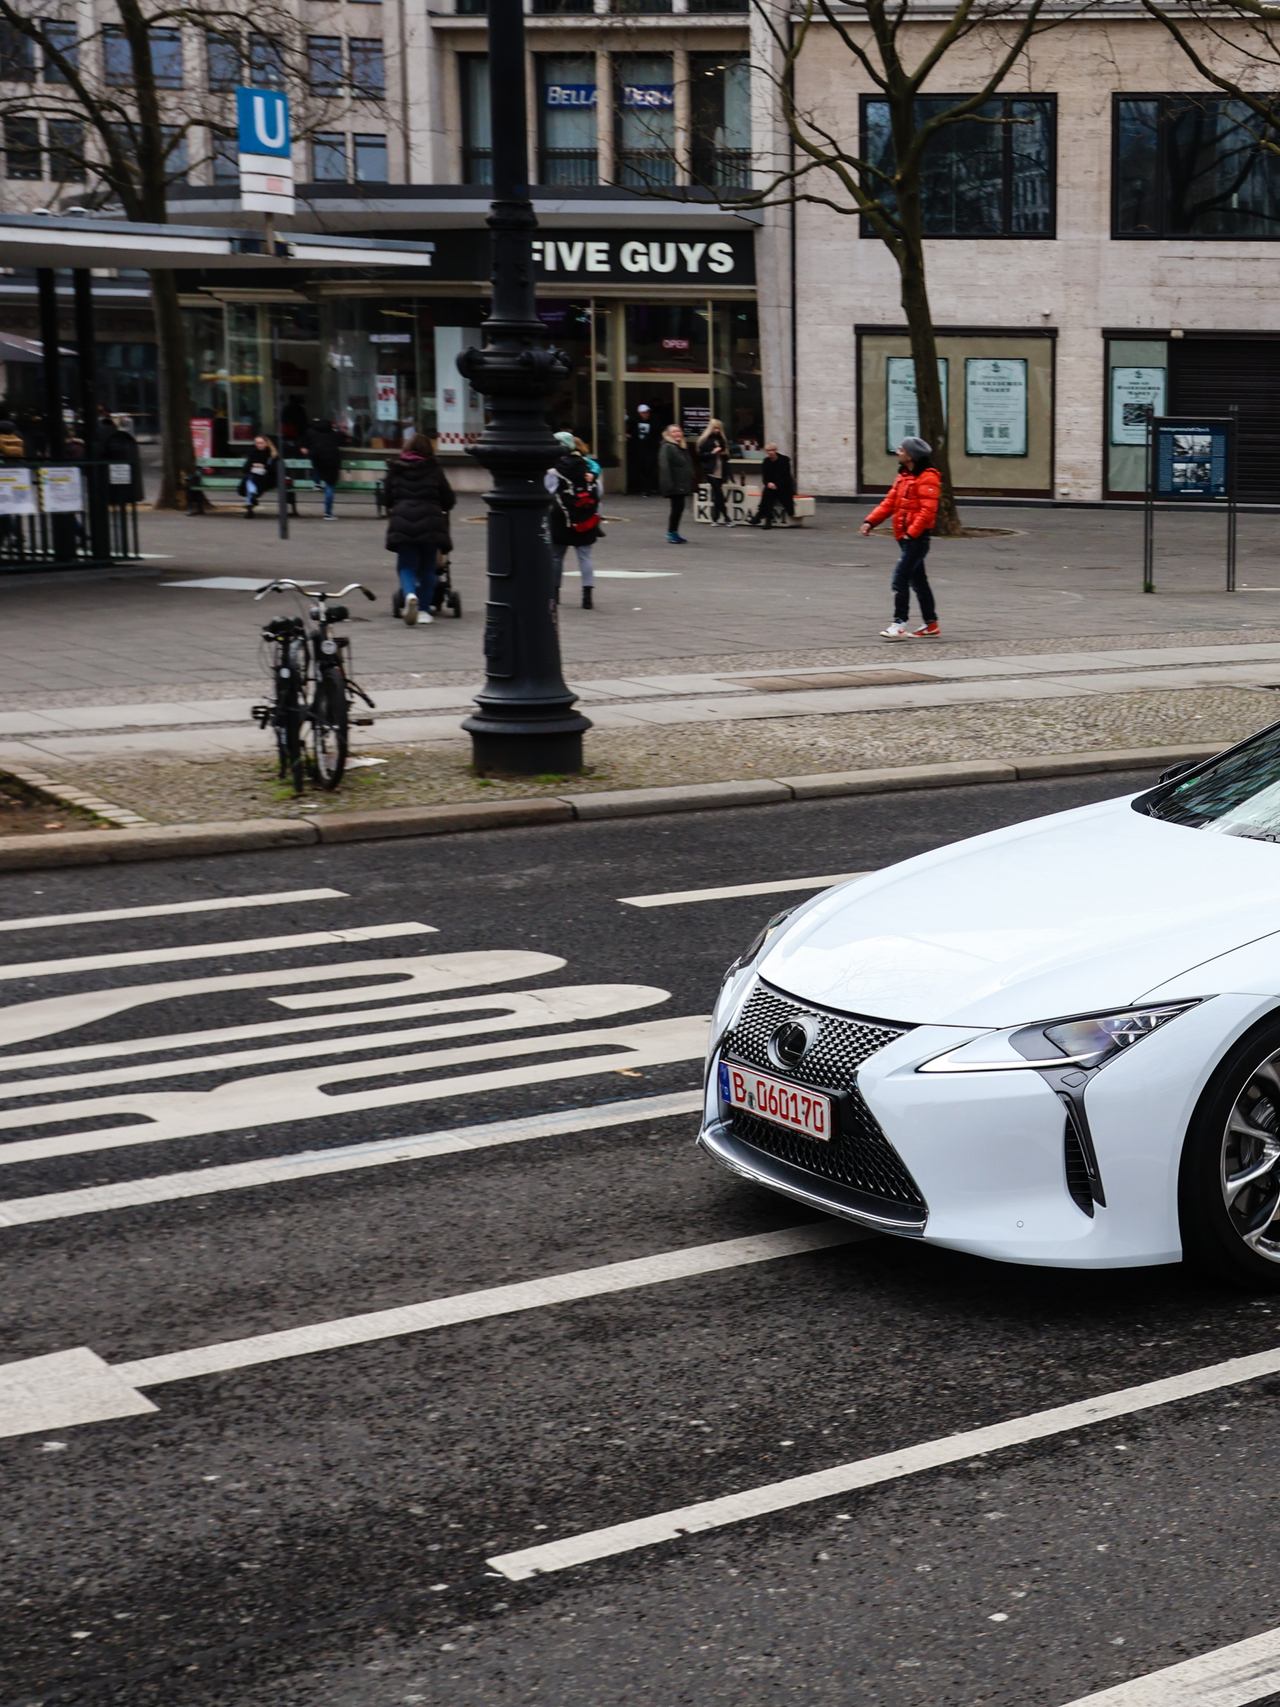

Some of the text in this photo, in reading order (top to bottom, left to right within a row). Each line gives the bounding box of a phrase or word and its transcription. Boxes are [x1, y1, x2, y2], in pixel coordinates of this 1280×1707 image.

[253, 95, 286, 149] U
[619, 241, 735, 273] GUYS
[662, 339, 690, 349] OPEN
[698, 488, 745, 504] BVD
[733, 1071, 824, 1133] B 060170
